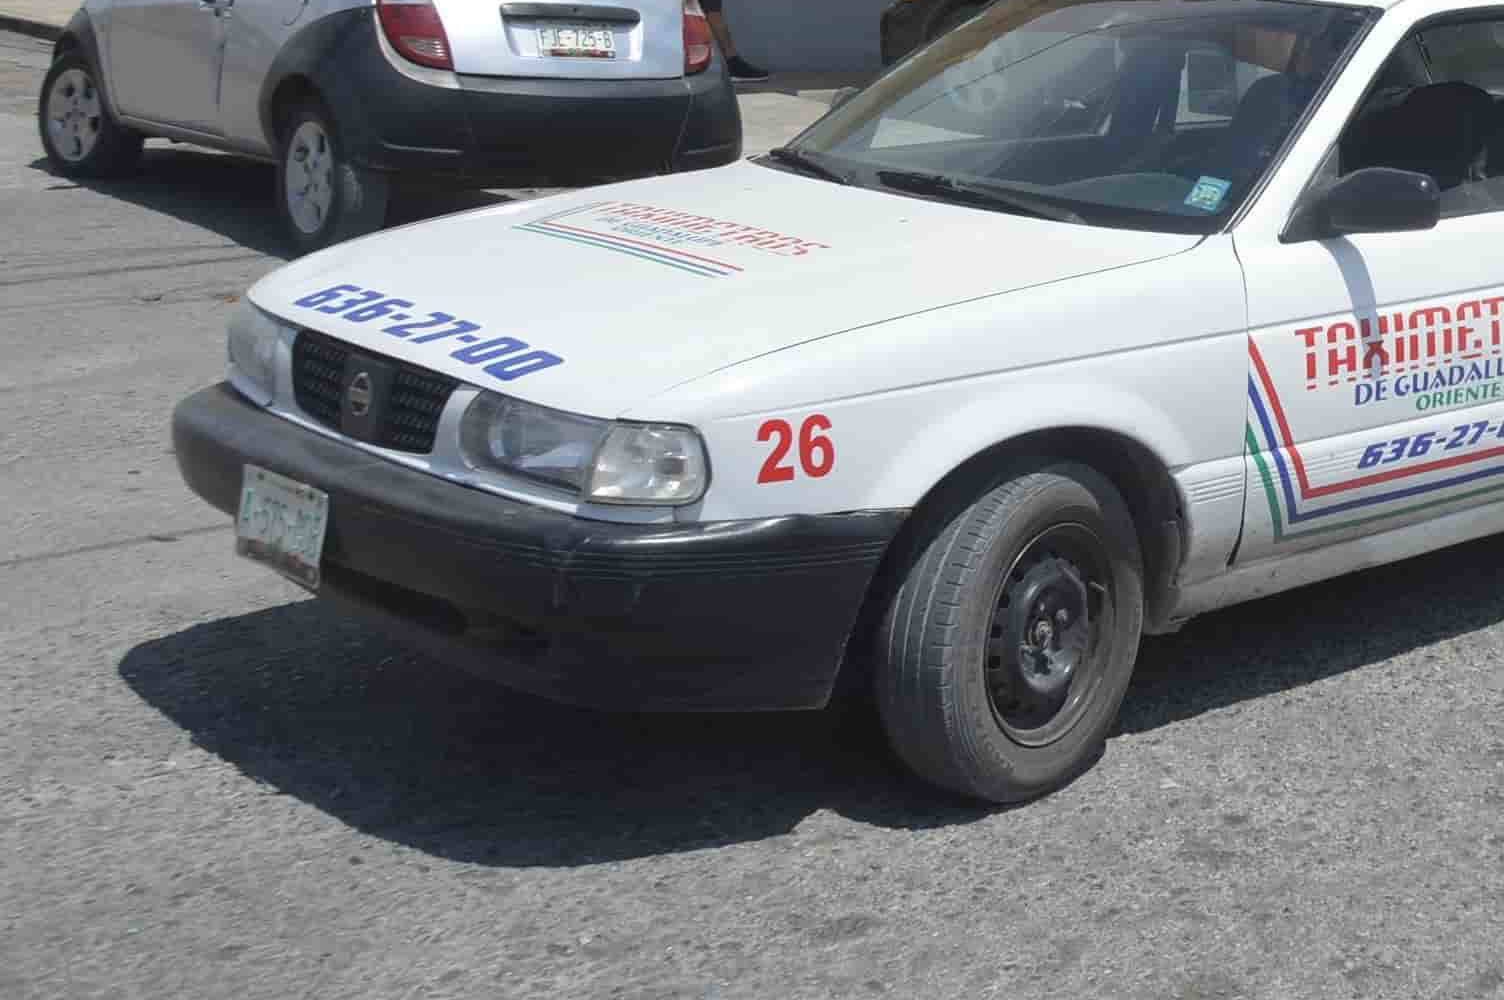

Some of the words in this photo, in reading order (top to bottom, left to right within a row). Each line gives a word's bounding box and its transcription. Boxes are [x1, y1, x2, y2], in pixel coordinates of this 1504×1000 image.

[292, 283, 564, 381] 636-27-00
[1354, 382, 1387, 406] DE
[1415, 381, 1502, 411] ORIENTE
[757, 414, 834, 484] 26
